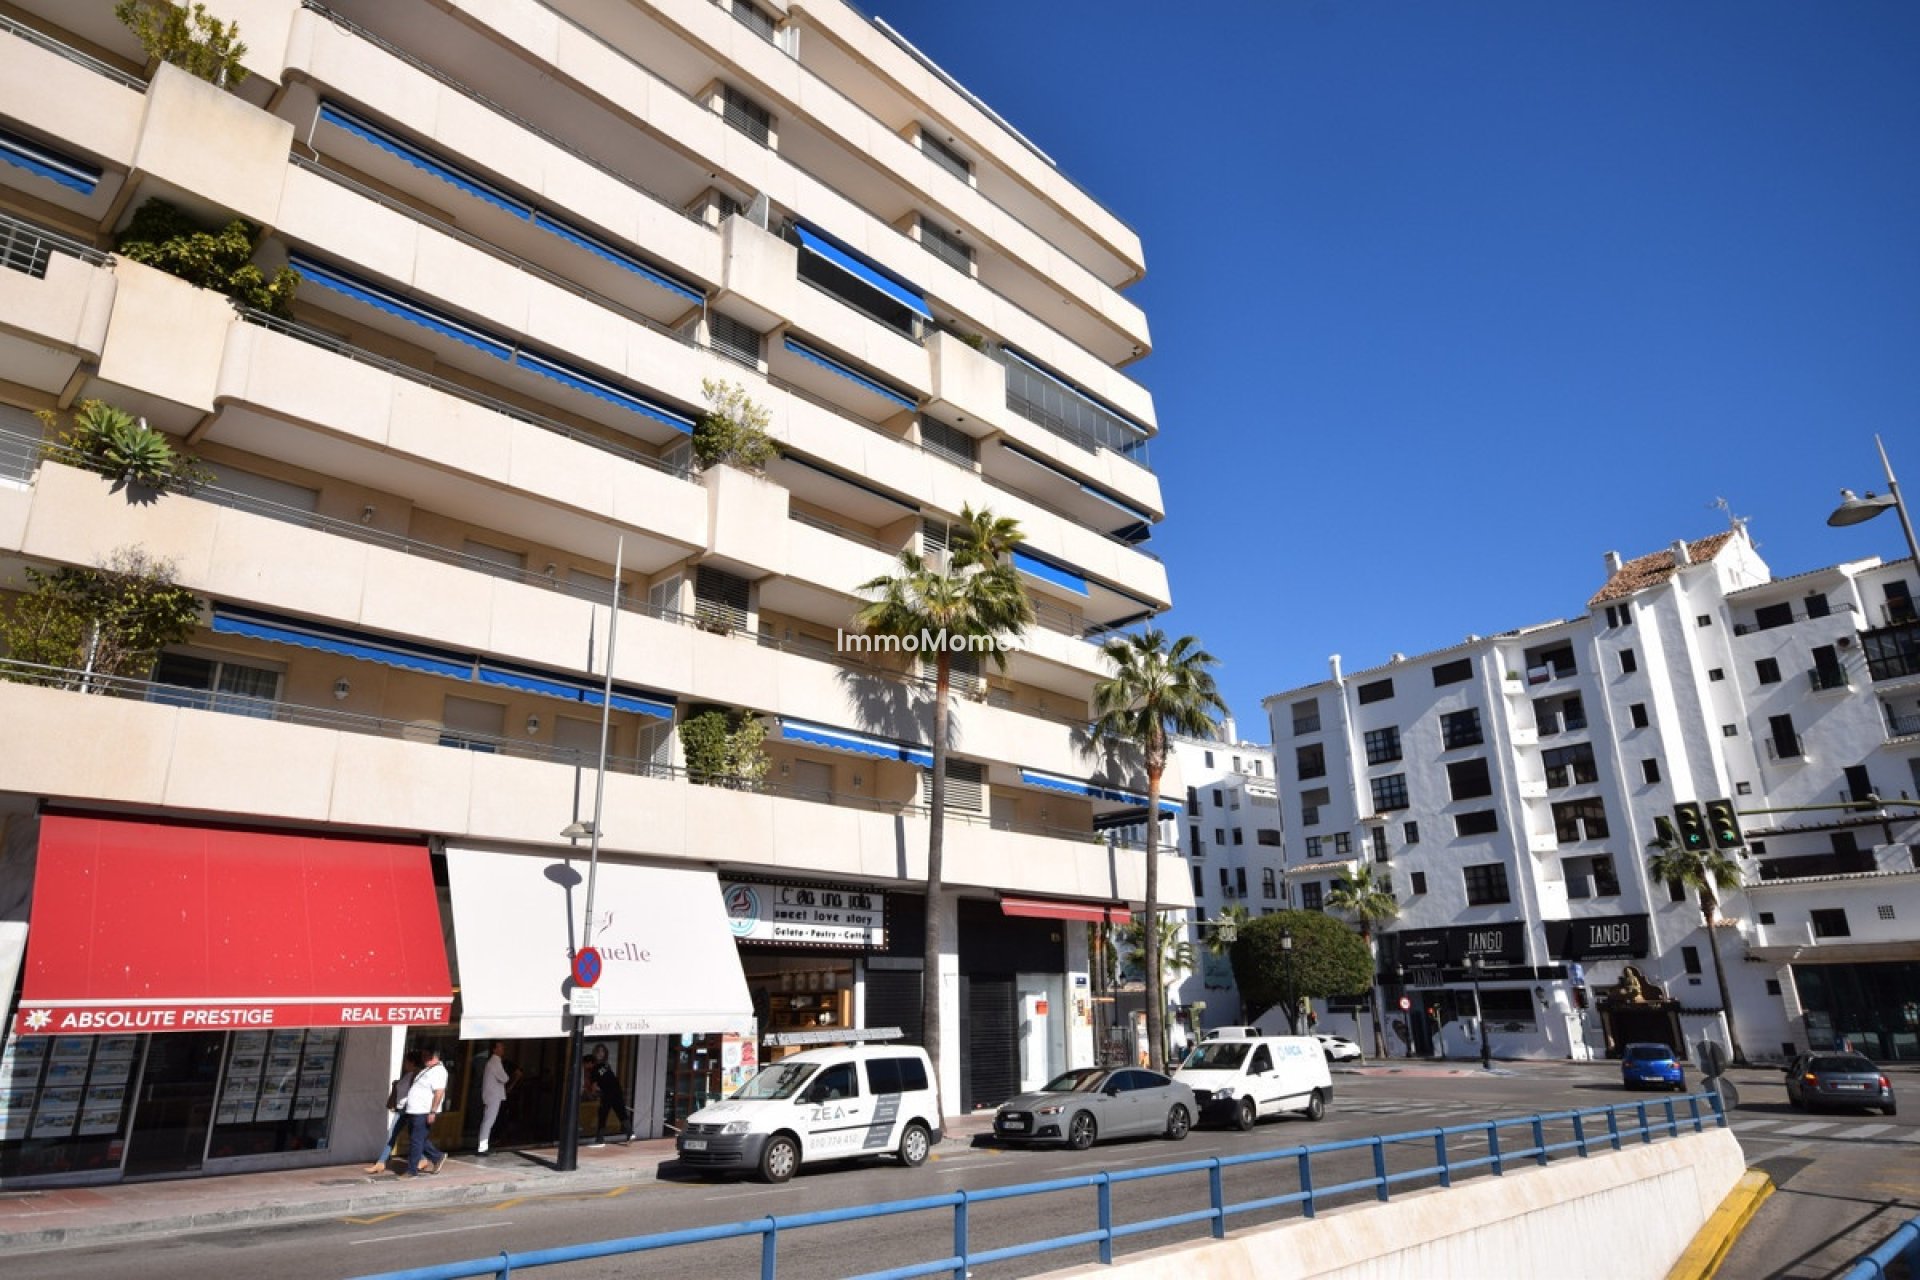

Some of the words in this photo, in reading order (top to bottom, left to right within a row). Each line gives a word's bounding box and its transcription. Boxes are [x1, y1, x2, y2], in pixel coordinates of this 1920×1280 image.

[774, 909, 807, 920] sweet
[814, 910, 841, 922] love
[846, 913, 873, 925] story
[775, 927, 804, 937] Gelato
[810, 929, 836, 939] Pastry
[1467, 931, 1503, 950] TANGO
[1588, 923, 1630, 943] TANGO
[60, 1009, 175, 1028] ABSOLUTE
[182, 1008, 274, 1025] PRESTIGE
[341, 1007, 382, 1021] REAL
[387, 1006, 443, 1021] ESTATE
[811, 1106, 845, 1121] ZEA
